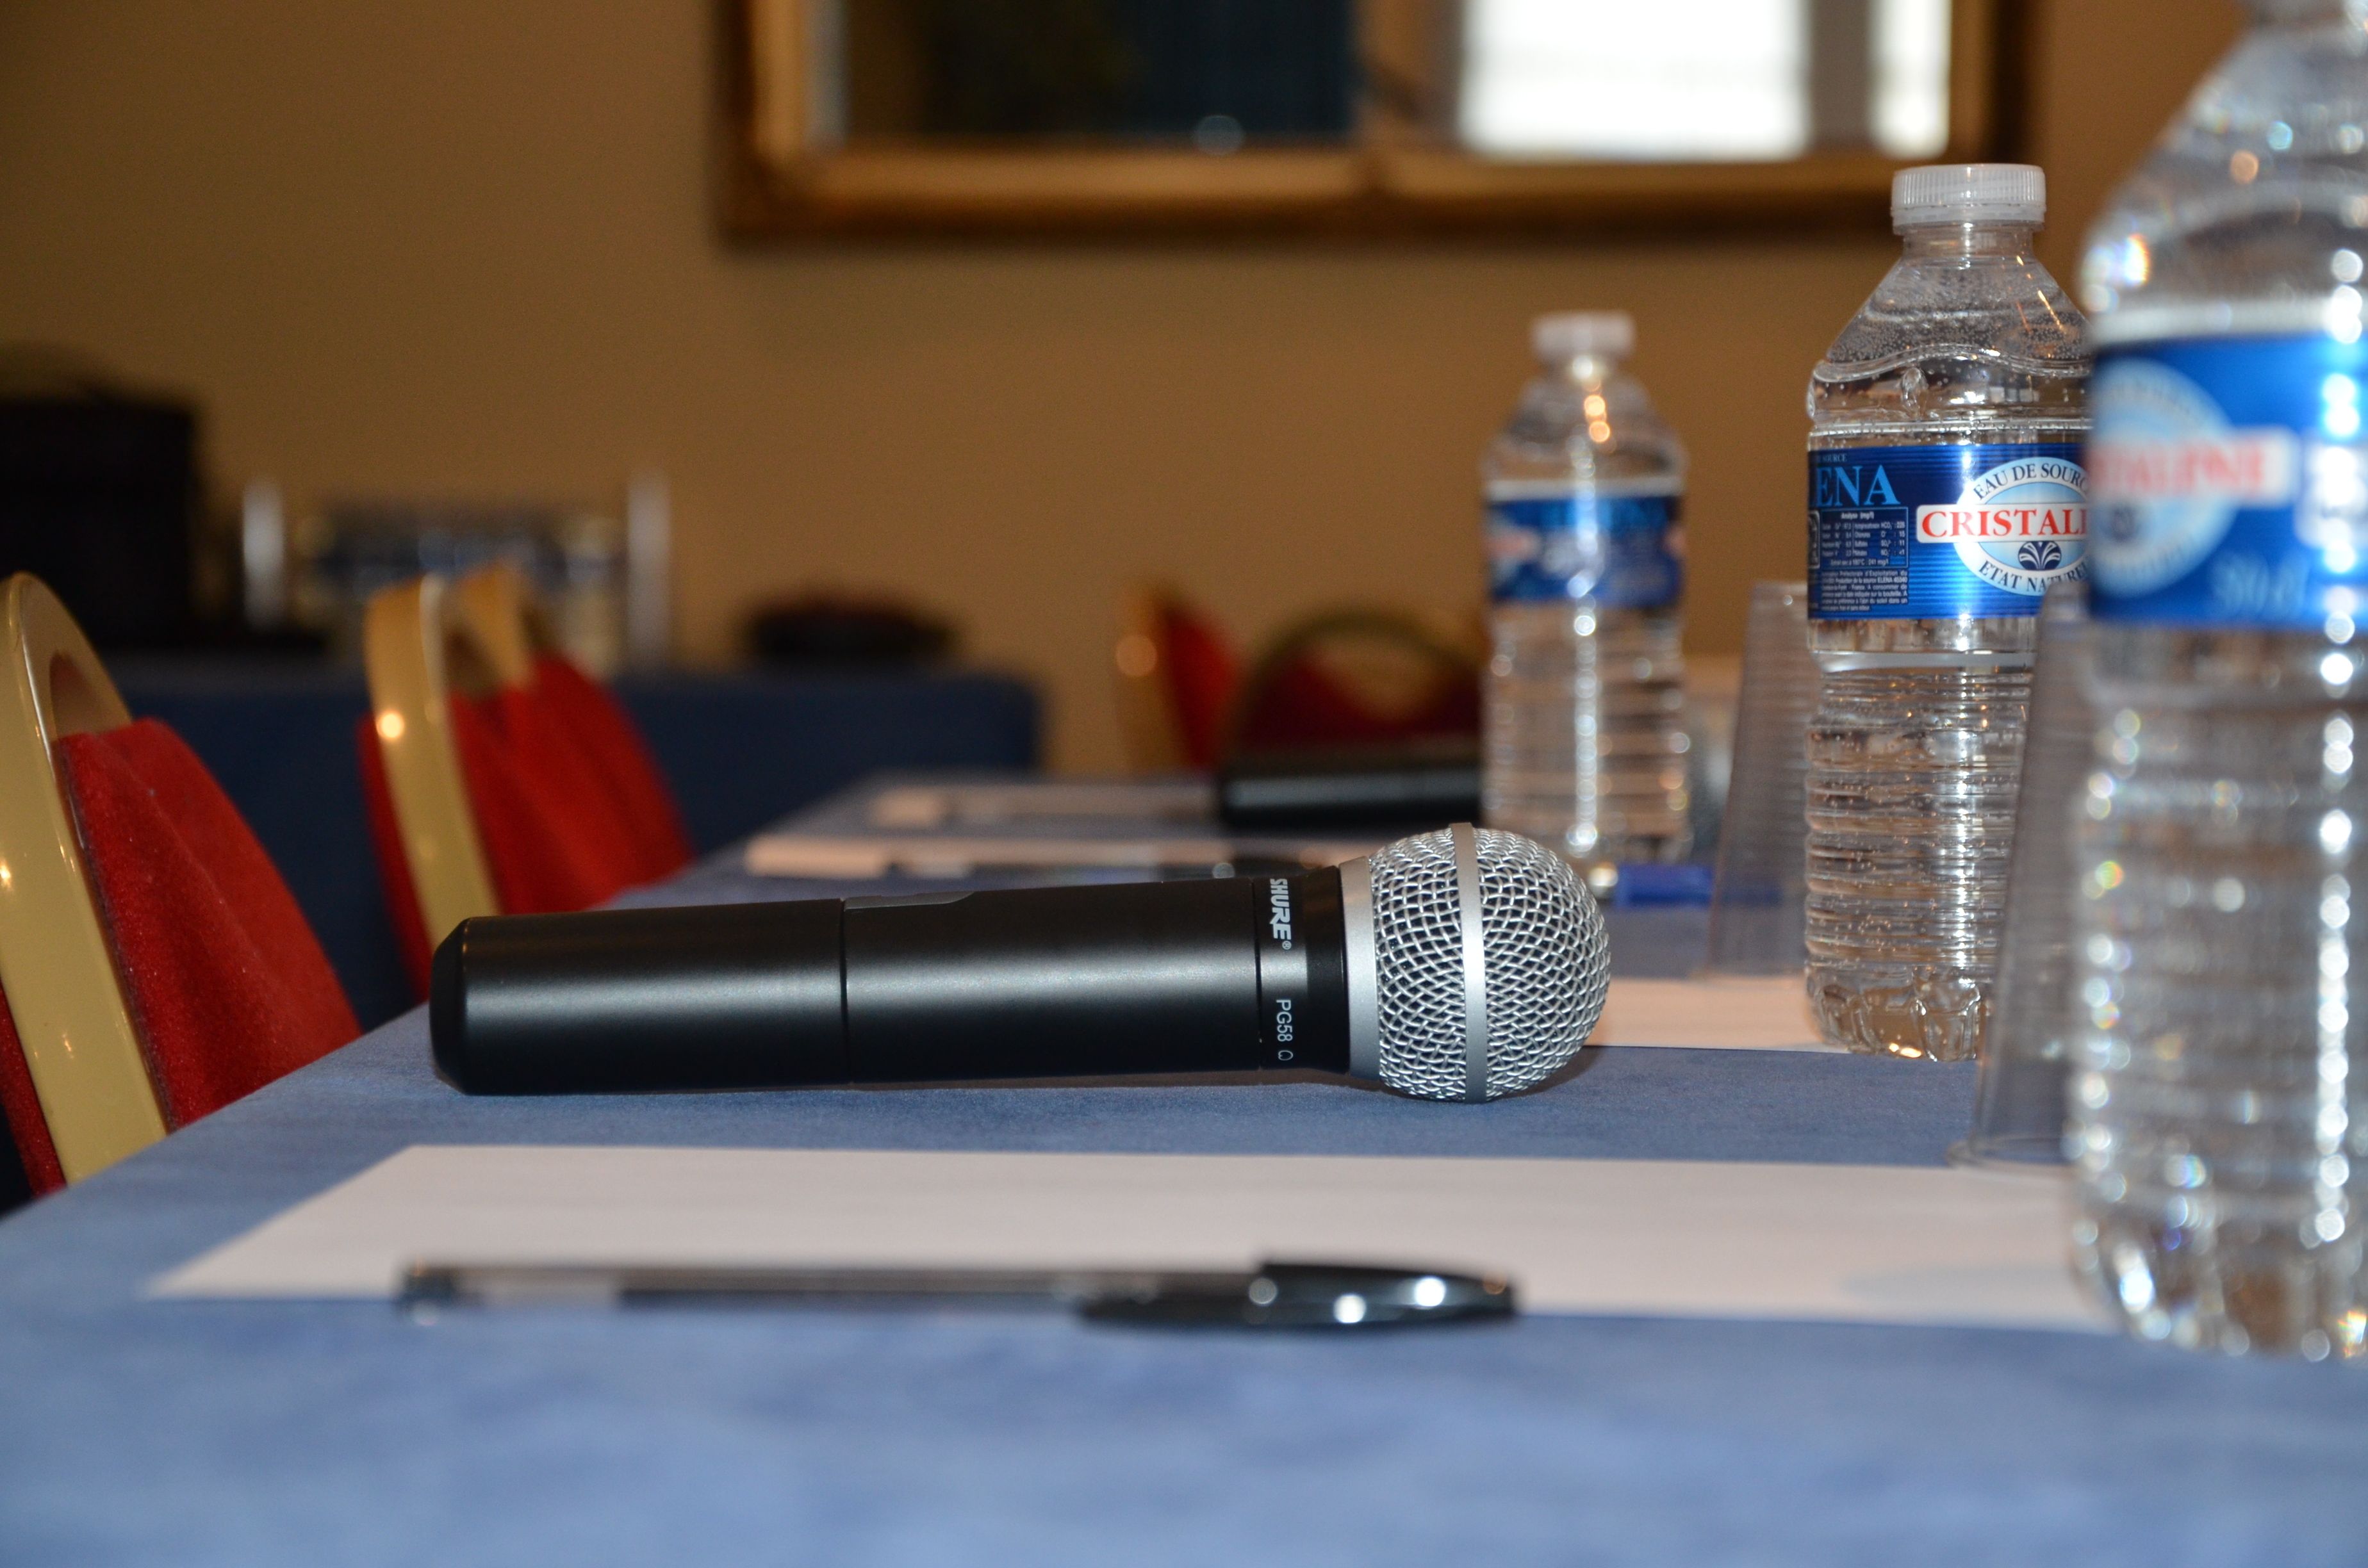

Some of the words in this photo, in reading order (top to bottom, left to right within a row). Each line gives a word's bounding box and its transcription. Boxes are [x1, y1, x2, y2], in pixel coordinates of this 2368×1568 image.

[1973, 470, 2009, 500] EAU
[2012, 463, 2037, 482] DE
[1978, 560, 2023, 589] ETAT
[1276, 999, 1293, 1042] PG58
